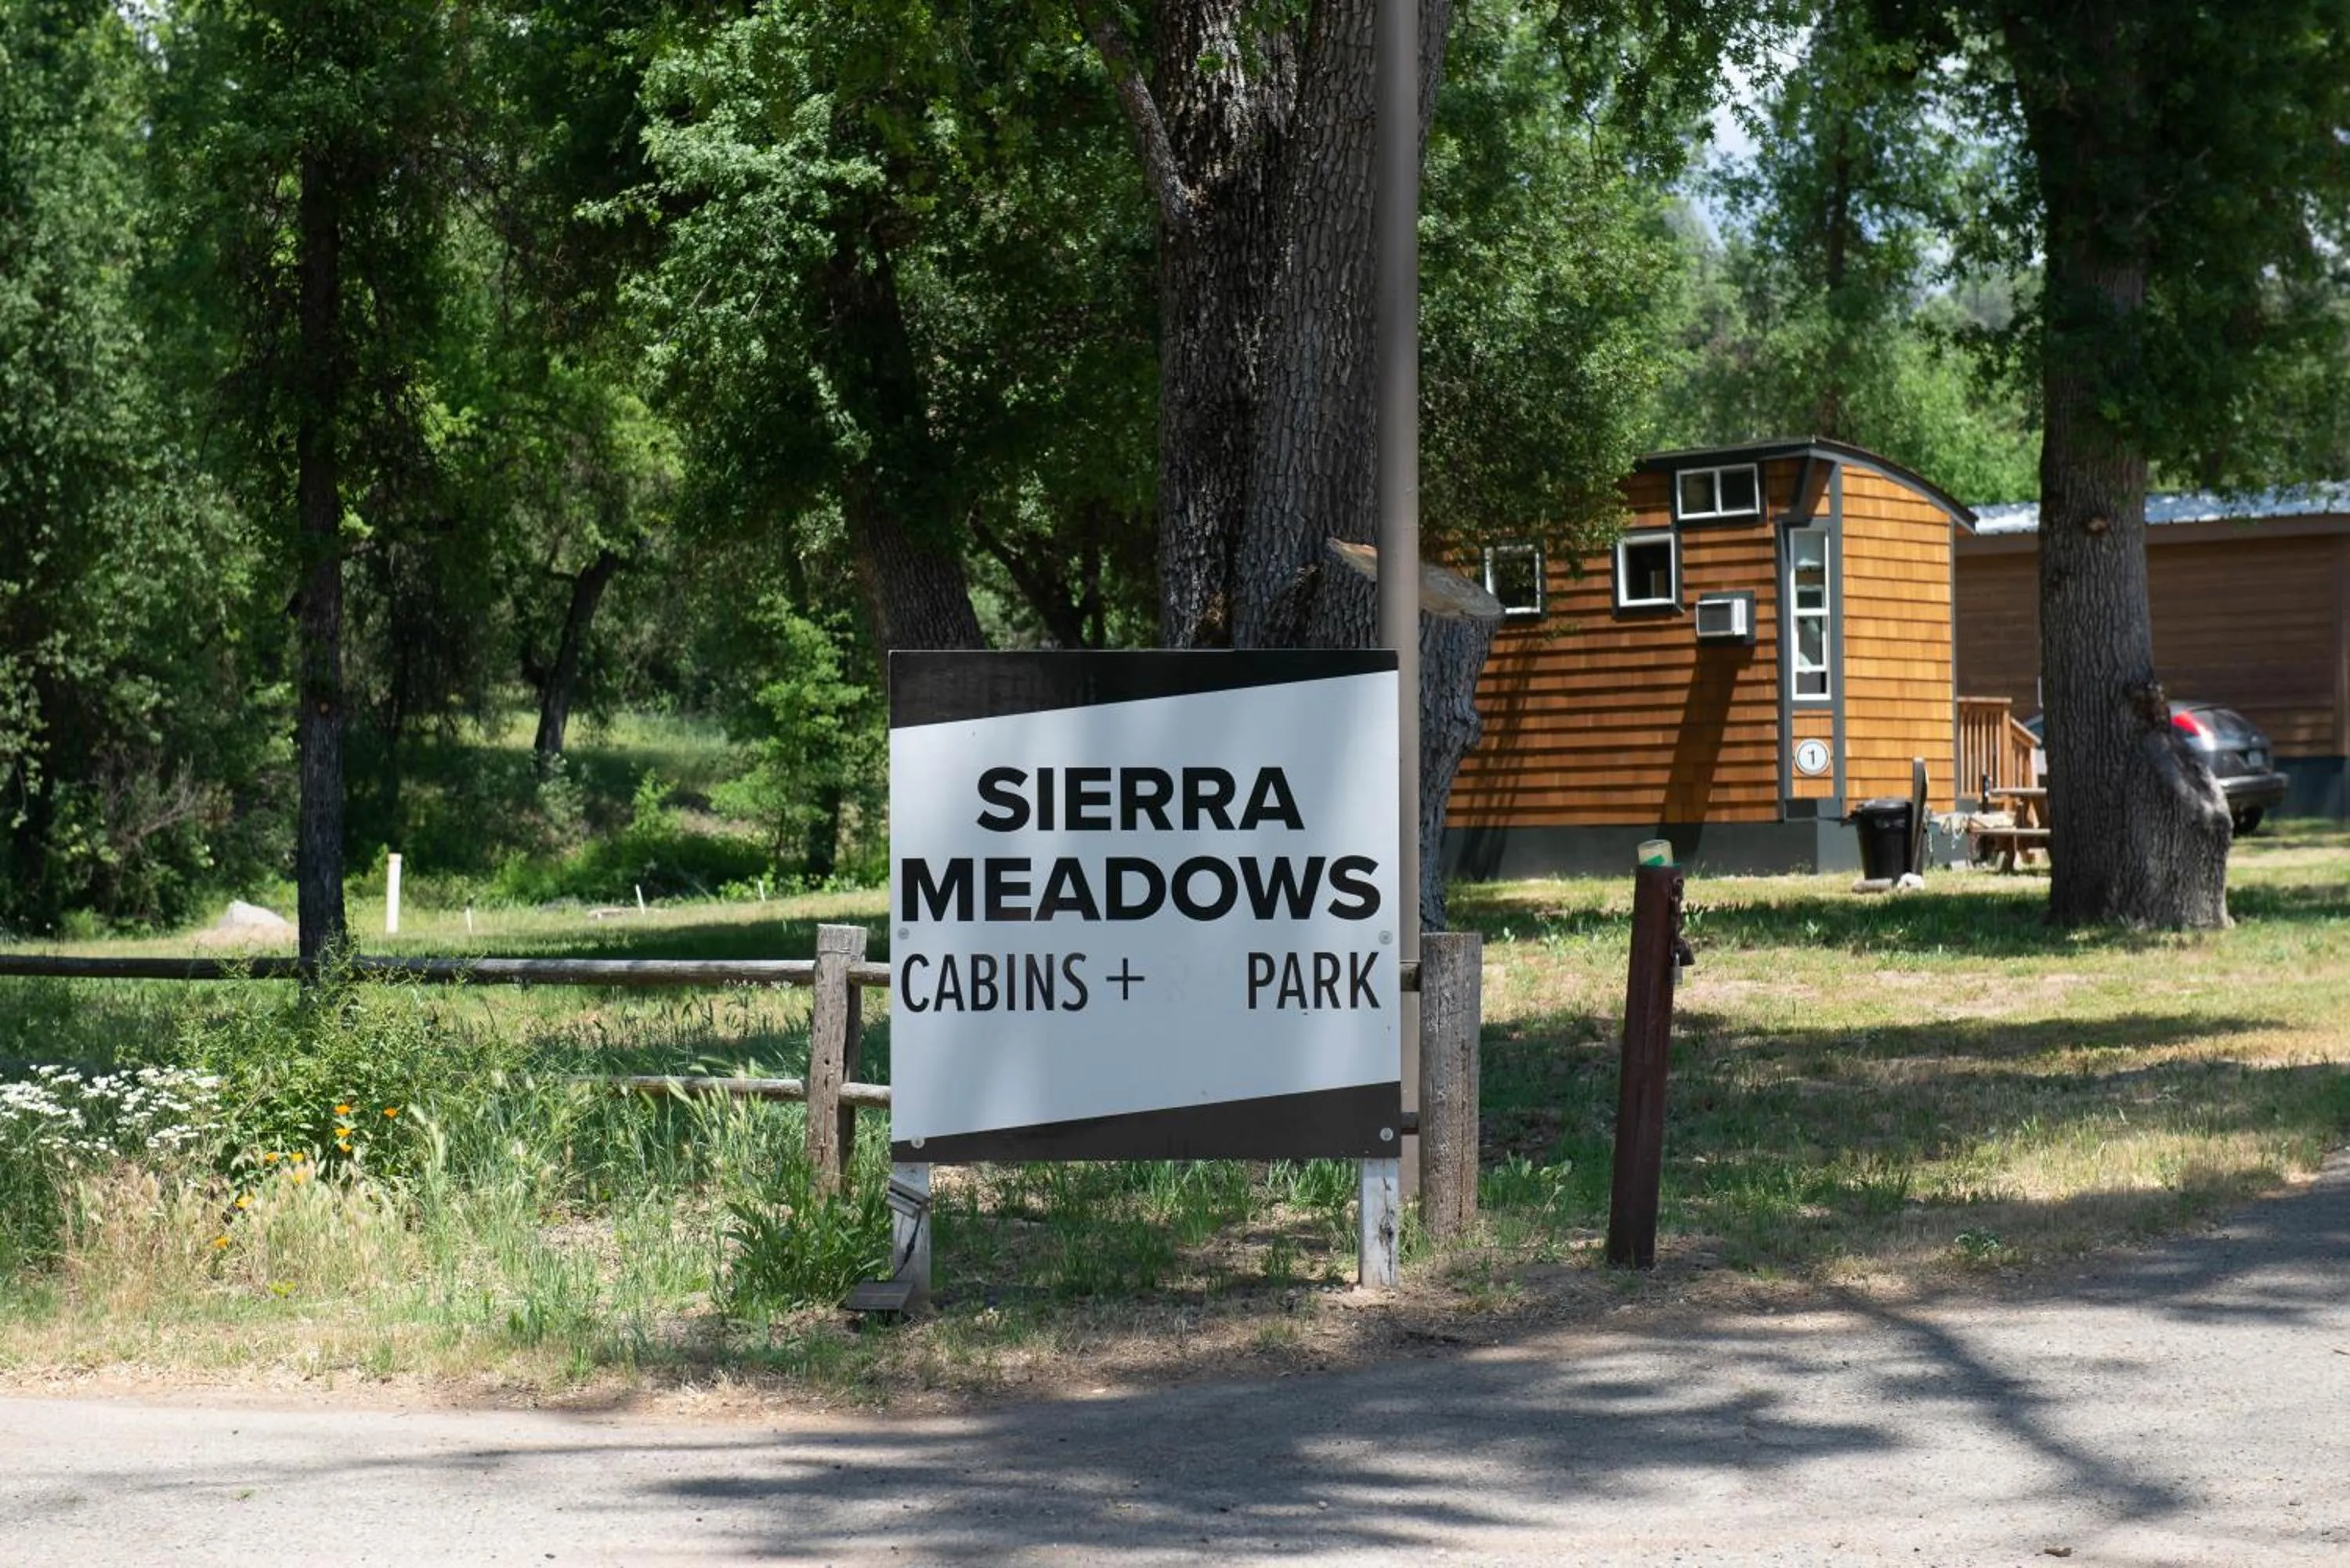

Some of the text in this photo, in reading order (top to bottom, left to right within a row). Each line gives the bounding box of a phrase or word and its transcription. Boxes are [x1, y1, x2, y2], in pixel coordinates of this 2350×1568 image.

[1807, 749, 1815, 765] 1
[977, 766, 1306, 833] SIERRA
[902, 855, 1381, 922] MEADOWS
[902, 952, 1089, 1013] CABINS
[1105, 957, 1145, 1001] +
[1248, 952, 1381, 1010] PARK
